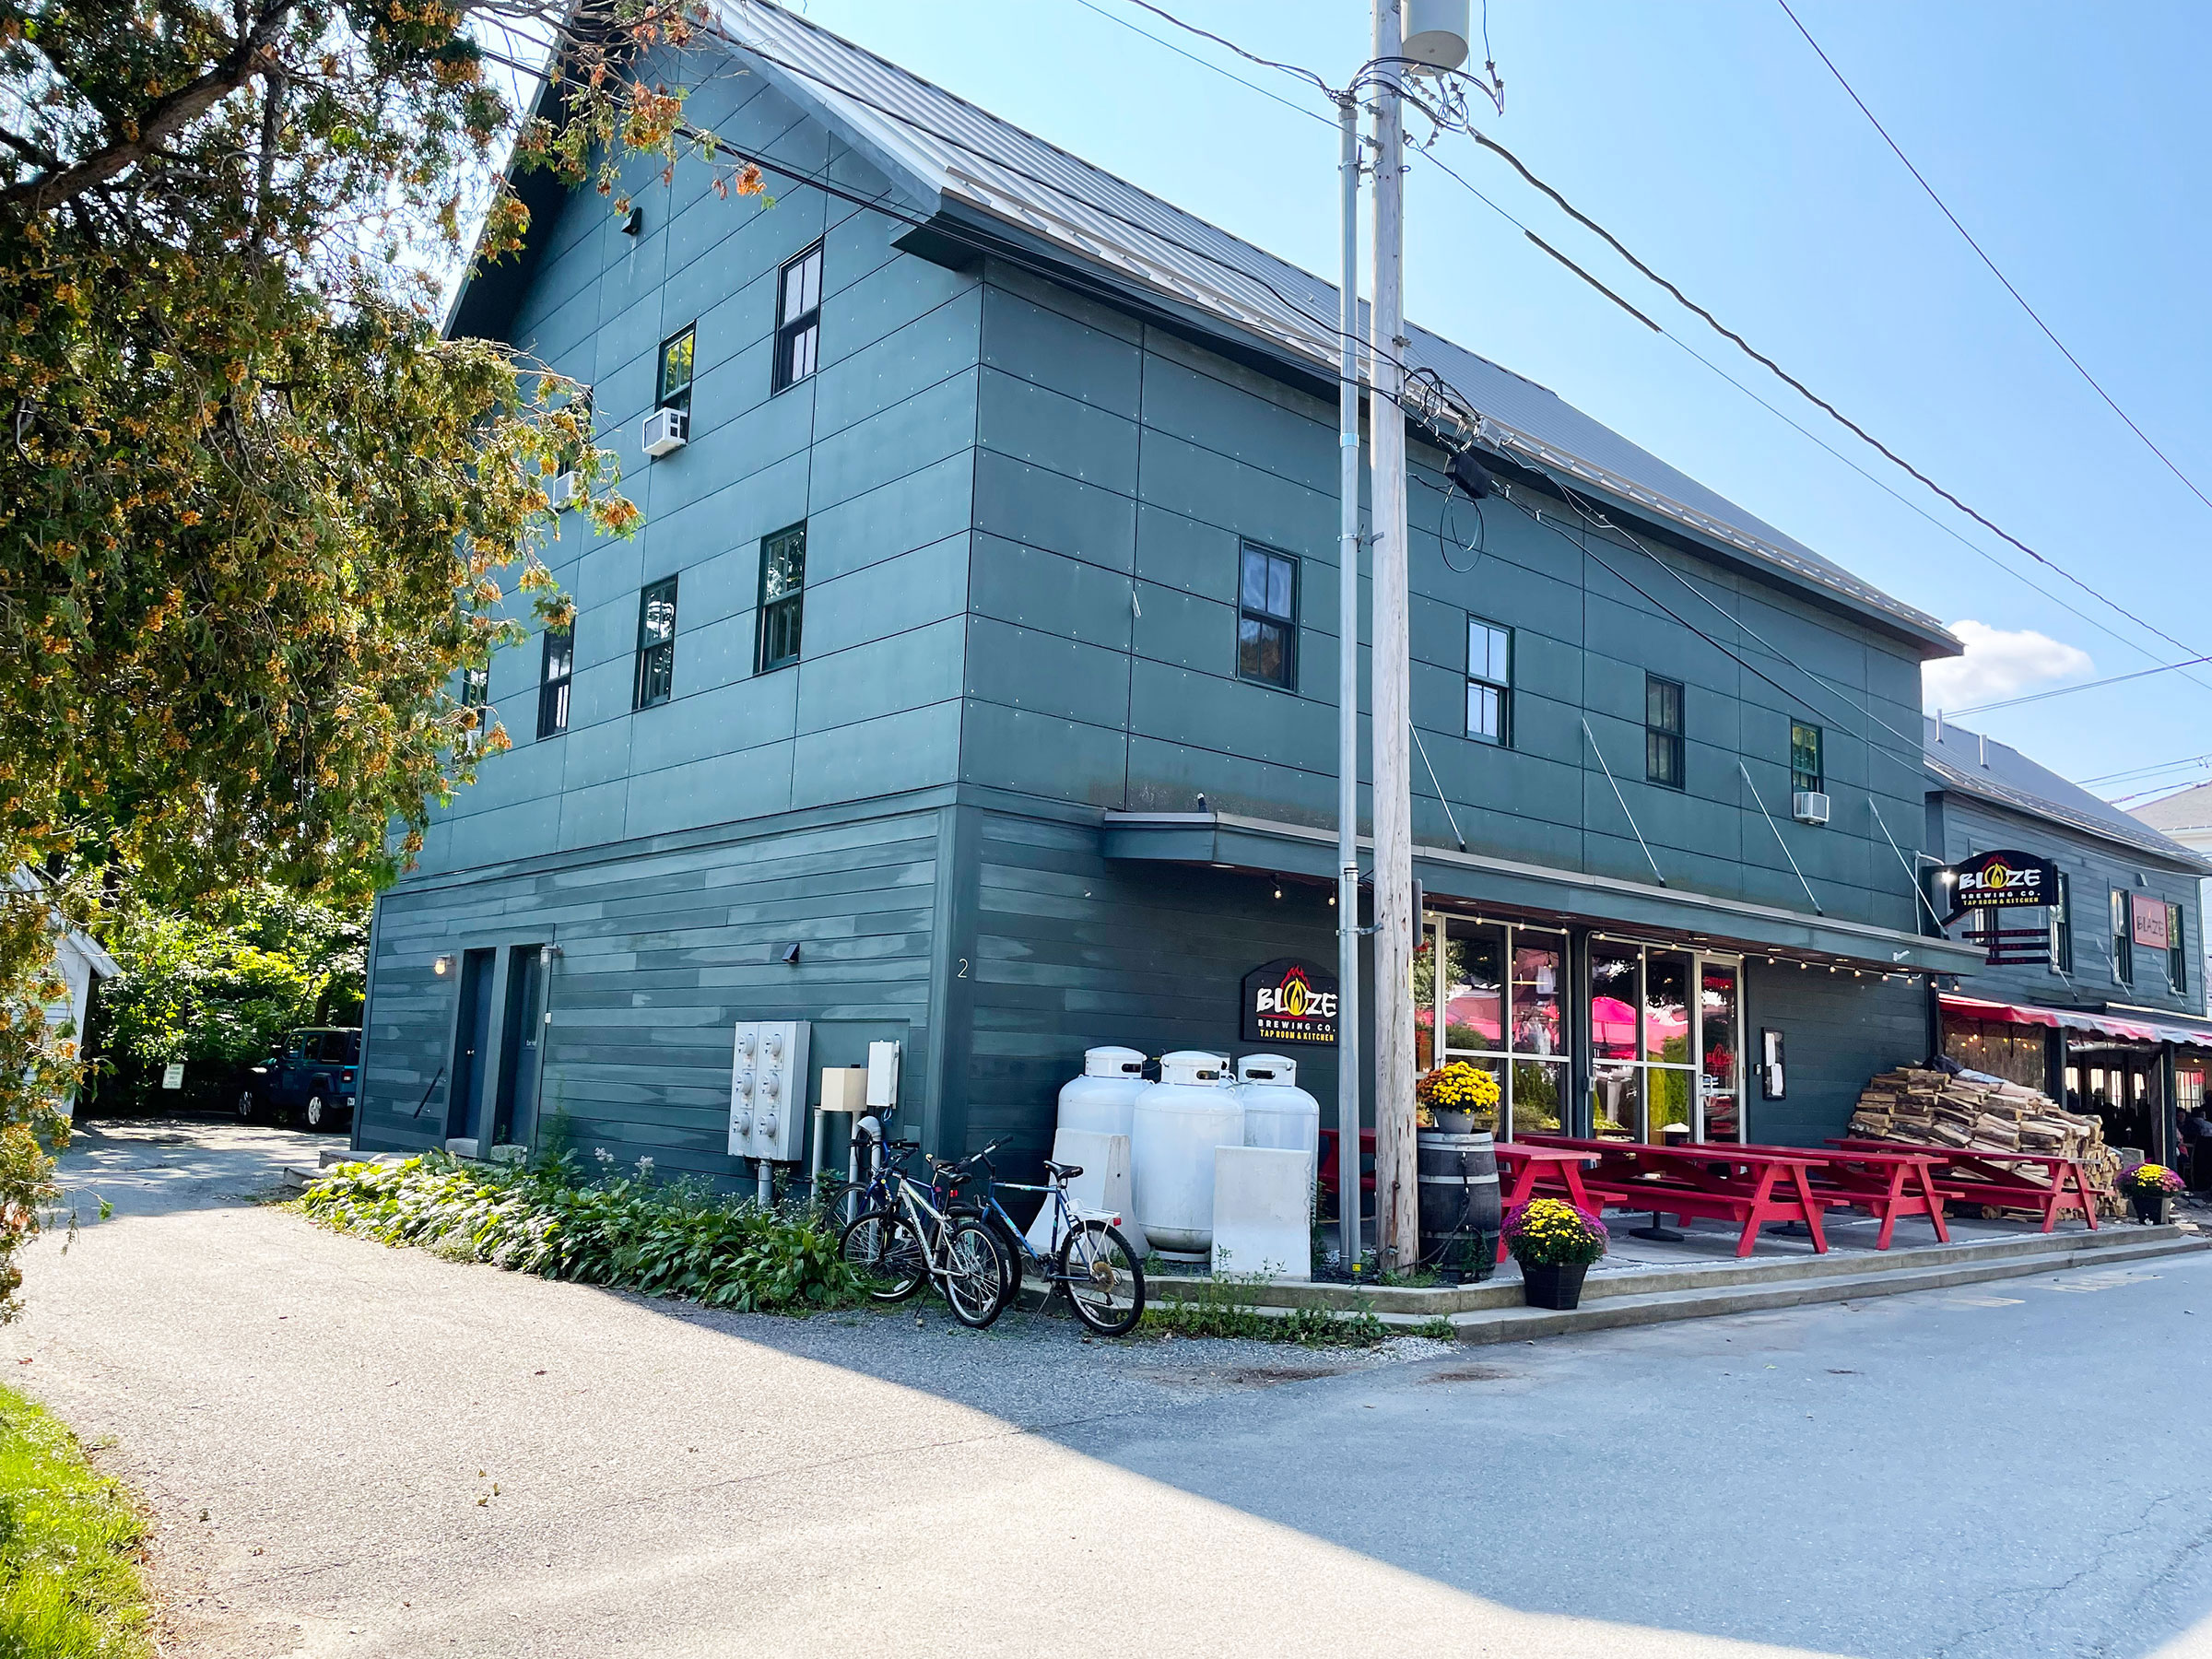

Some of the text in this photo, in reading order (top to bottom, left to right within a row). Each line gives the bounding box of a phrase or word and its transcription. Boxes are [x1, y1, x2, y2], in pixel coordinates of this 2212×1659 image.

[1959, 864, 2041, 890] BLAZE
[1961, 891, 2013, 900] BREWING
[2136, 915, 2164, 936] BLAZE
[958, 959, 968, 978] 2
[1256, 977, 1338, 1018] BLAZE
[1258, 1019, 1335, 1032] BREWING CO.
[1260, 1029, 1274, 1037] TAP
[1276, 1030, 1295, 1039] ROOM
[1303, 1032, 1334, 1041] KITCHEN
